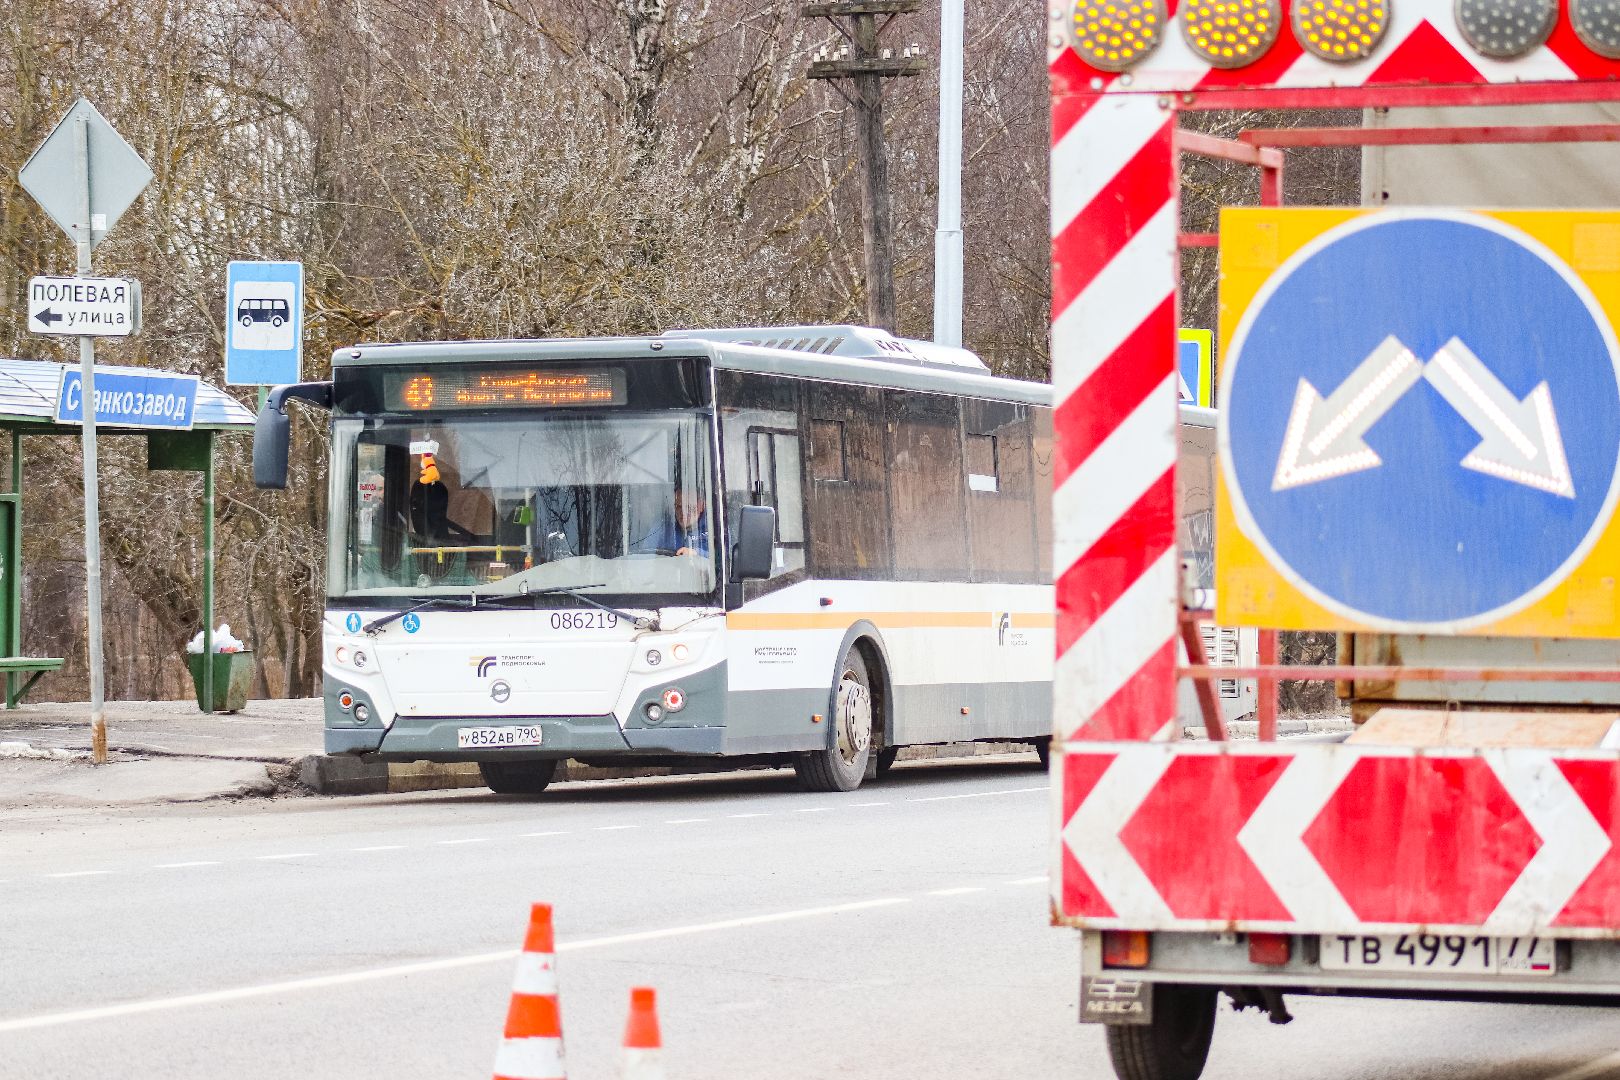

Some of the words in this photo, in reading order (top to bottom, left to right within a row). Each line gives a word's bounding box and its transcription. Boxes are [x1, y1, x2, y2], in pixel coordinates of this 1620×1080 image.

[33, 284, 126, 303] ПОЛЕВАЯ
[67, 310, 125, 326] улица
[66, 378, 187, 421] Санкозавод
[550, 612, 618, 630] 086219
[1393, 934, 1490, 967] 4991
